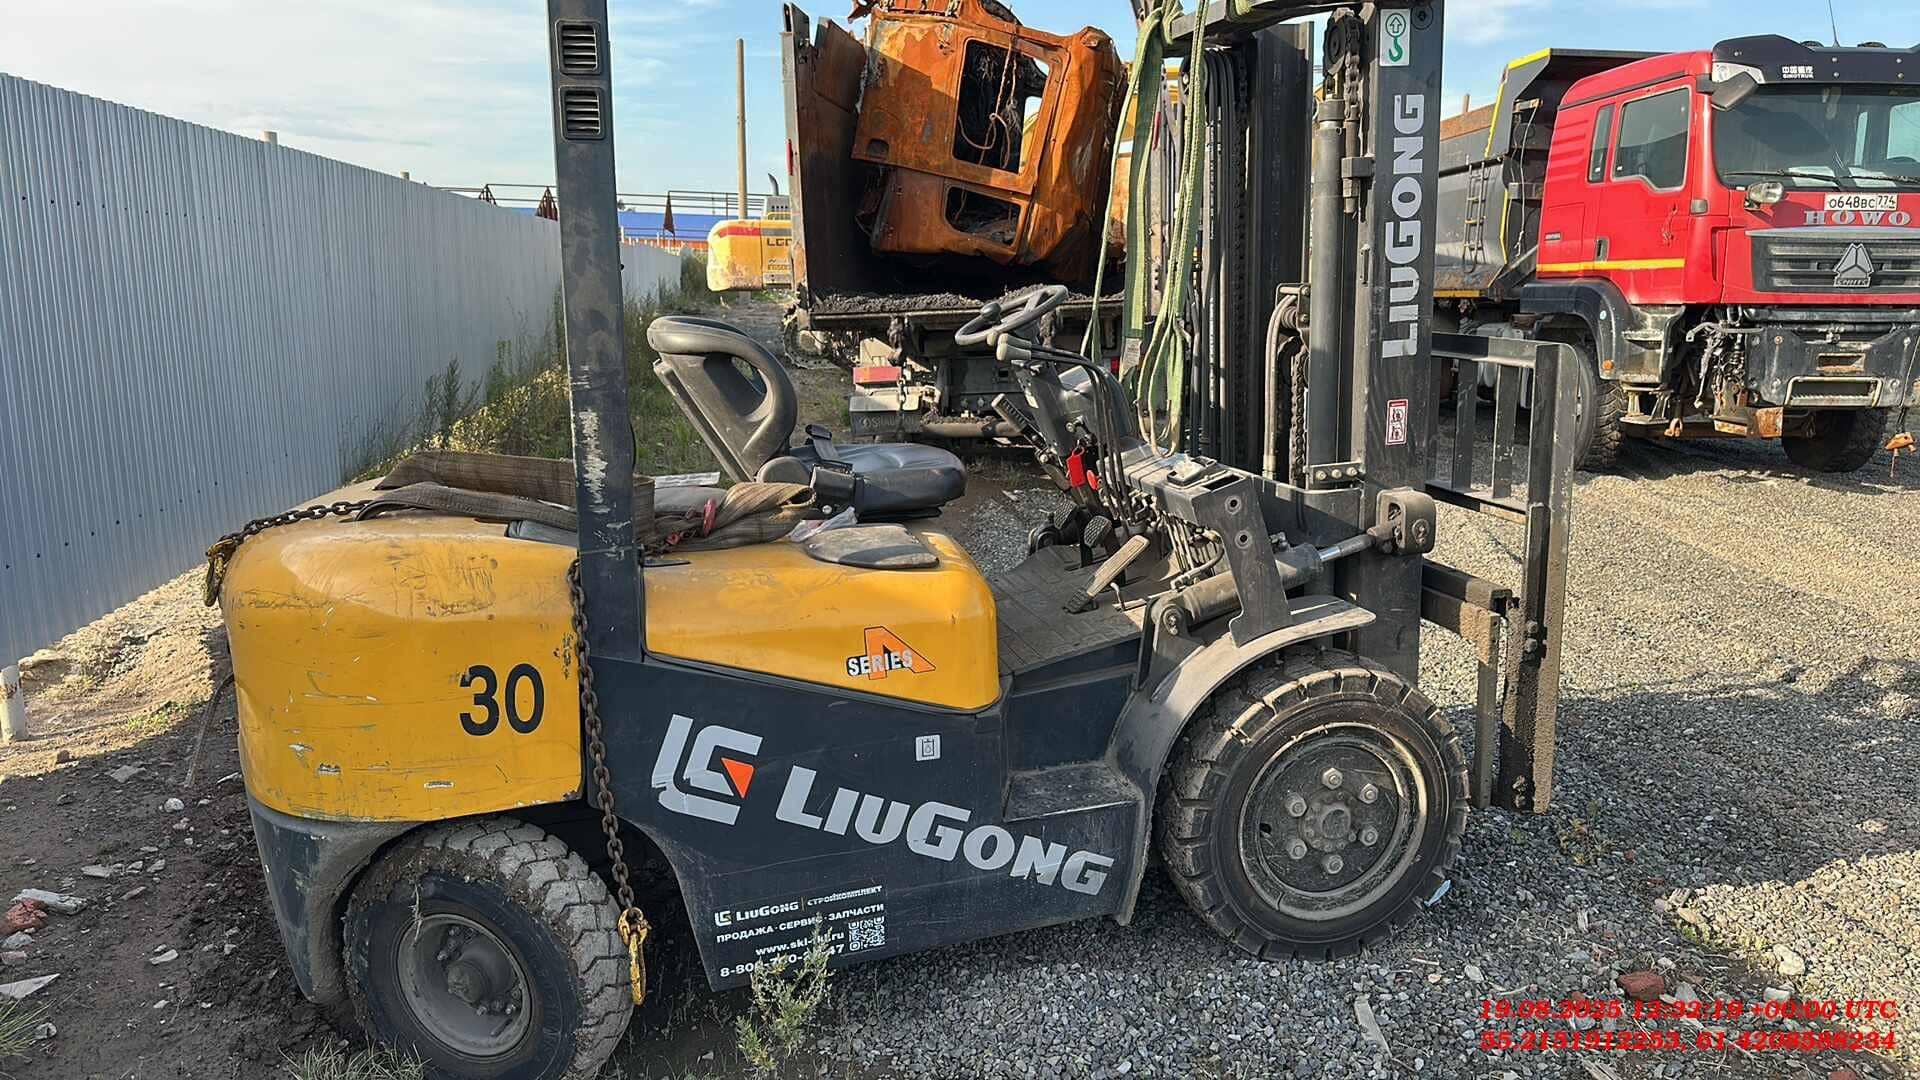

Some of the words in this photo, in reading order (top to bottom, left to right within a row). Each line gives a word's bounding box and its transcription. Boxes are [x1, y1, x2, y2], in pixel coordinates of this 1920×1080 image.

[1382, 94, 1425, 359] LIUGONG
[1803, 210, 1911, 225] HOWO
[847, 648, 913, 677] SERIES
[459, 663, 545, 737] 30
[775, 764, 1115, 896] LIUGONG
[716, 925, 775, 943] ПРОДАЖА
[828, 903, 884, 921] ЗАПЧАСТИ
[736, 901, 800, 921] LIUGONG
